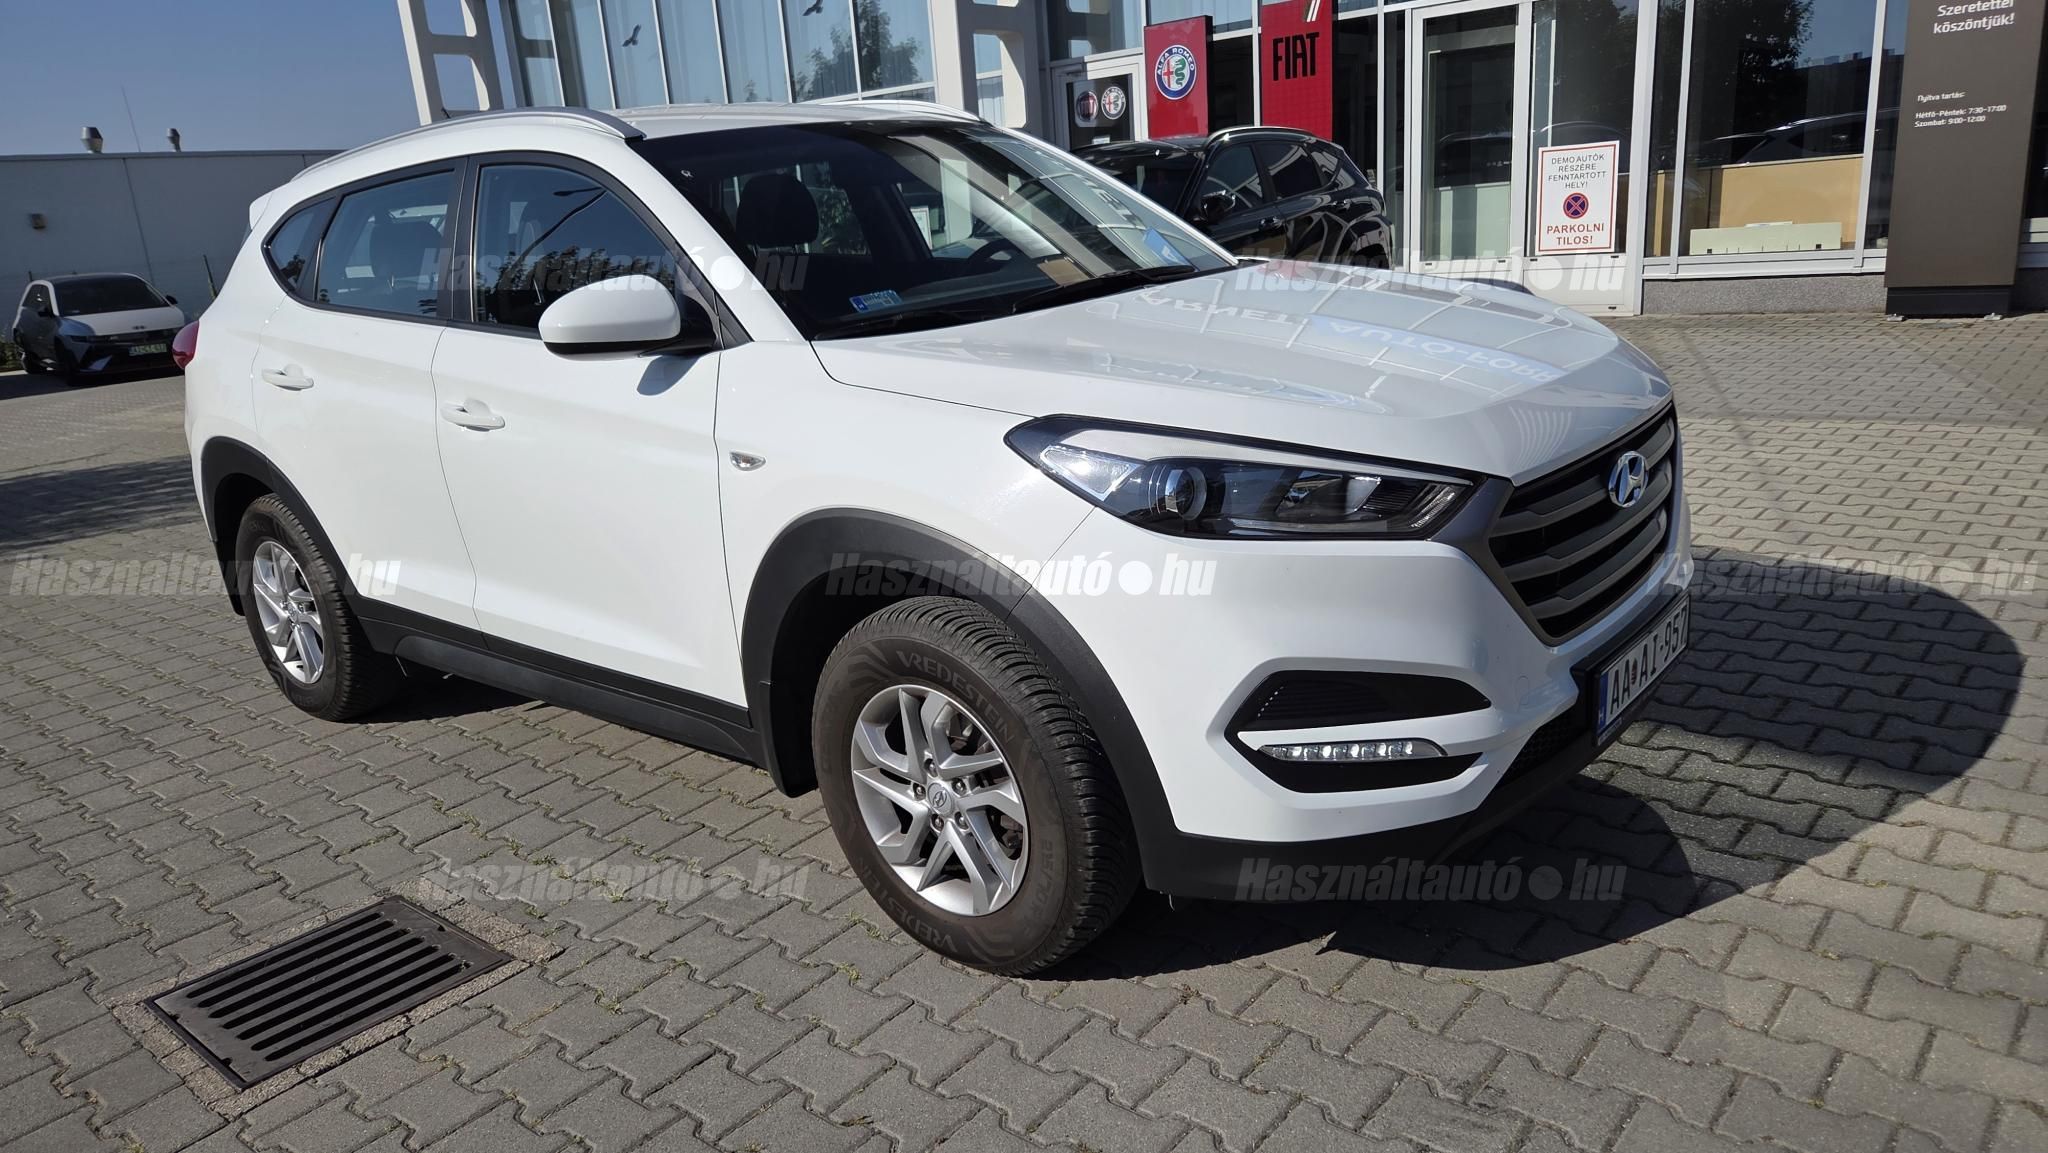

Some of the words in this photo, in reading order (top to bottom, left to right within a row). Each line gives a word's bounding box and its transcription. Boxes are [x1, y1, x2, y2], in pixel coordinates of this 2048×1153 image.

[1933, 12, 2015, 34] köszöntjük!
[1157, 52, 1170, 75] ALFA
[1172, 47, 1195, 71] ROMEO
[1272, 32, 1319, 81] FIAT
[1917, 94, 1940, 103] Nyitva
[1968, 105, 2007, 114] 7:30-17:00
[1914, 118, 1947, 127] Szombat:
[1948, 115, 1986, 125] 9:00-12:00
[1551, 156, 1575, 165] DEMO
[1576, 153, 1605, 163] AUTÓK
[1558, 162, 1597, 173] RÉSZÉRE
[1548, 171, 1607, 182] FENNTARTOTT
[1565, 181, 1588, 189] HELY!
[1546, 222, 1604, 234] PARKOLNI
[1556, 235, 1593, 246] TILOS!
[1610, 659, 1631, 715] AA
[895, 650, 1016, 744] VREDESTEIN
